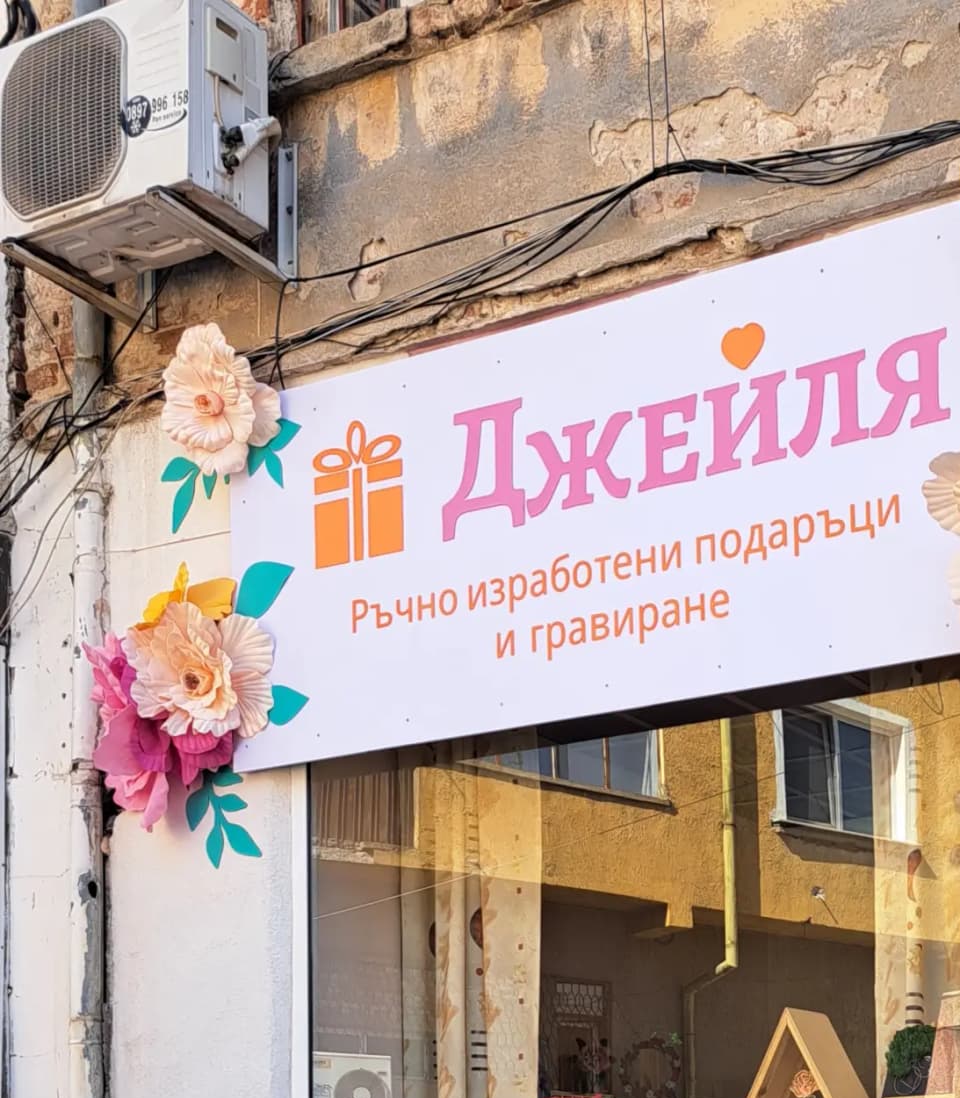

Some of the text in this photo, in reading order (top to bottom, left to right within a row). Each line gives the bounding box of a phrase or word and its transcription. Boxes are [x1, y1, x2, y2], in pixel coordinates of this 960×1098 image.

[152, 96, 167, 113] 996
[172, 89, 189, 108] 158
[351, 494, 900, 632] Ръчно изработени подаръци
[495, 586, 730, 660] и гравиране
